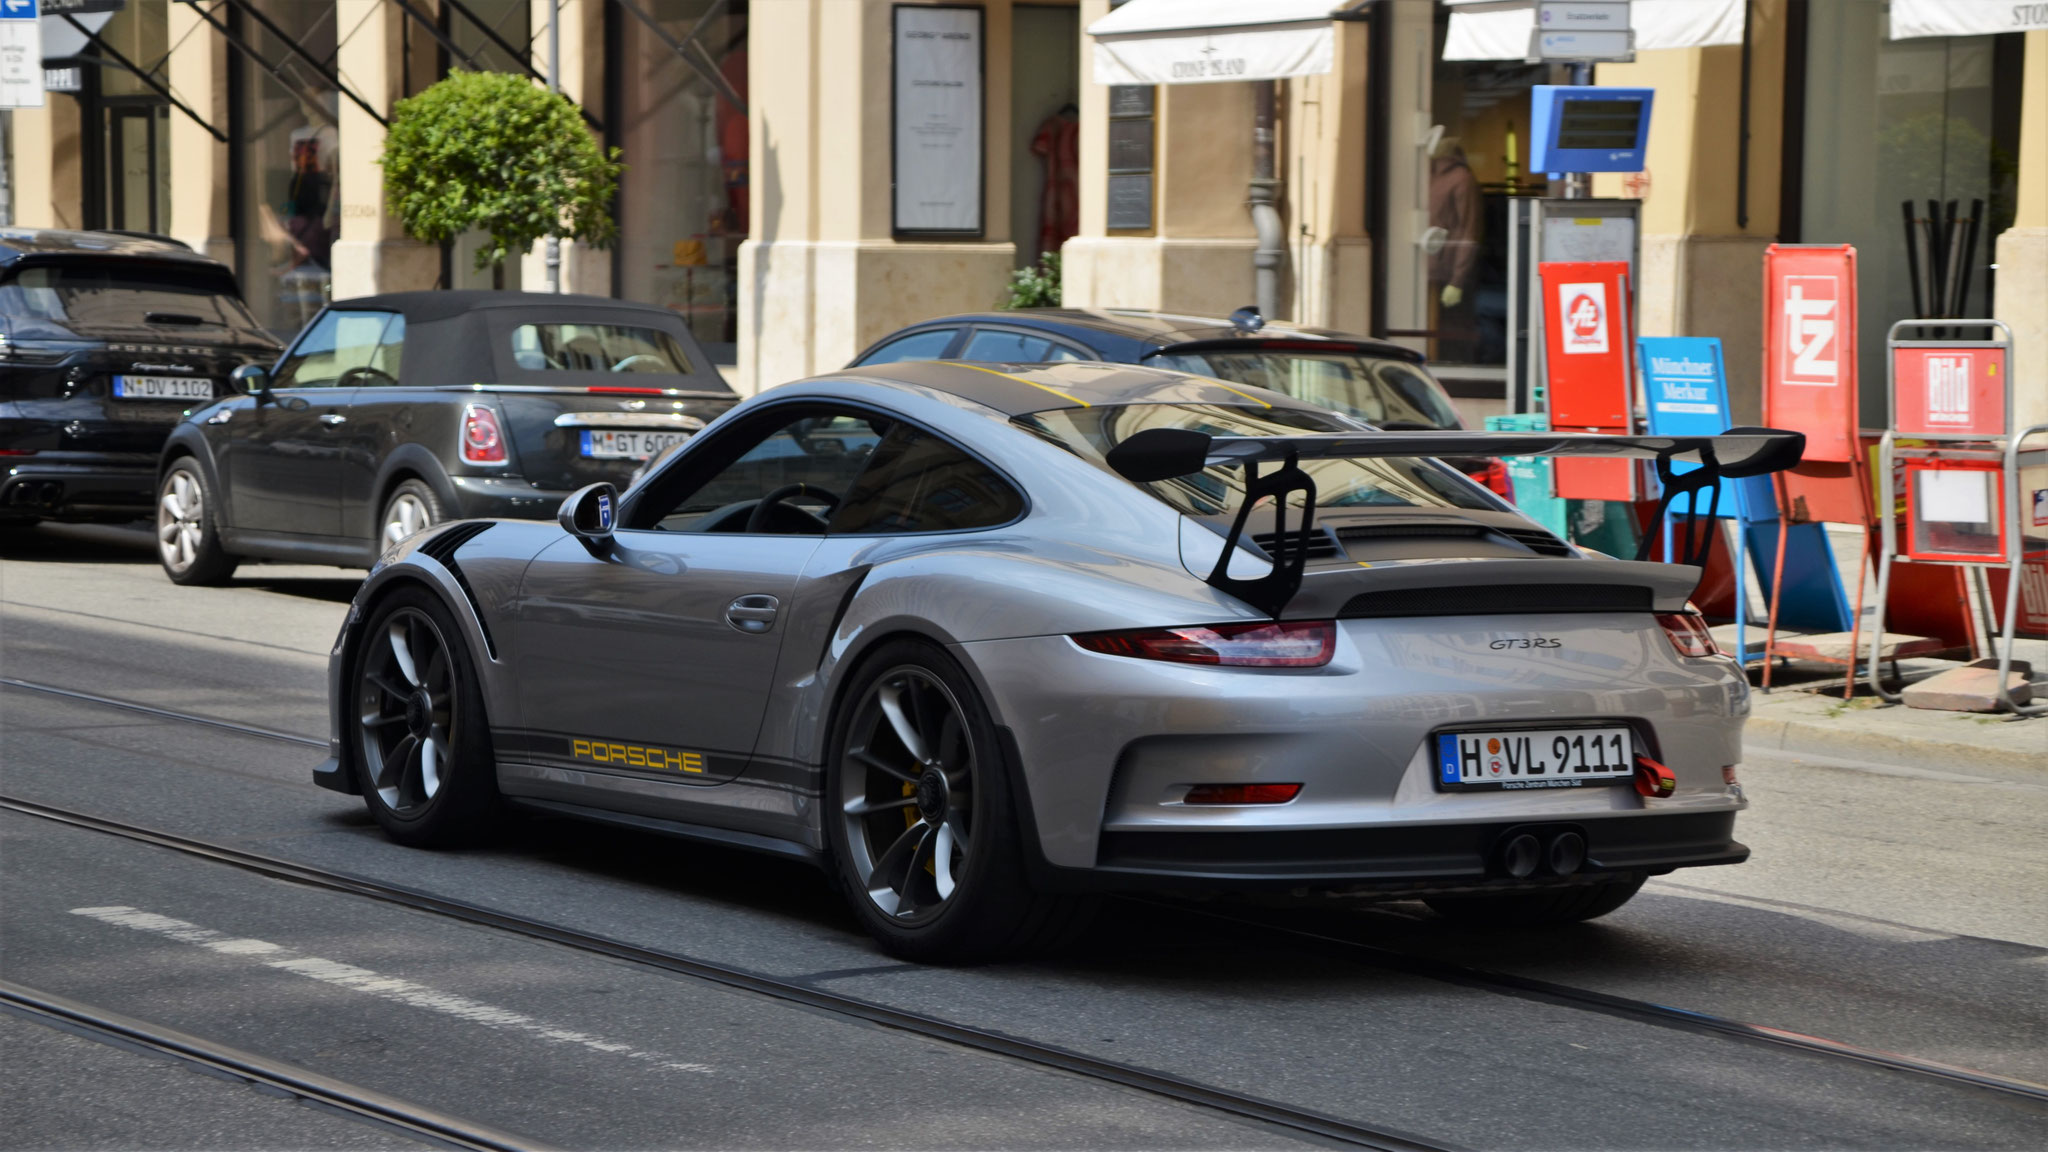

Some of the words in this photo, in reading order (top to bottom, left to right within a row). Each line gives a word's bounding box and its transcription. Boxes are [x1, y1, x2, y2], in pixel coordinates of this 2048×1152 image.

[2012, 3, 2048, 25] STO
[1784, 285, 1838, 375] tz
[108, 344, 213, 355] PORSCHE
[124, 380, 135, 393] N
[146, 379, 167, 395] DV
[171, 381, 211, 397] 1102
[1663, 382, 1708, 401] Merkur
[592, 435, 604, 452] M
[616, 434, 640, 452] GT
[573, 739, 703, 774] PORSCHE
[1460, 738, 1483, 777] H
[1503, 737, 1546, 776] VL
[1552, 733, 1629, 774] 9111
